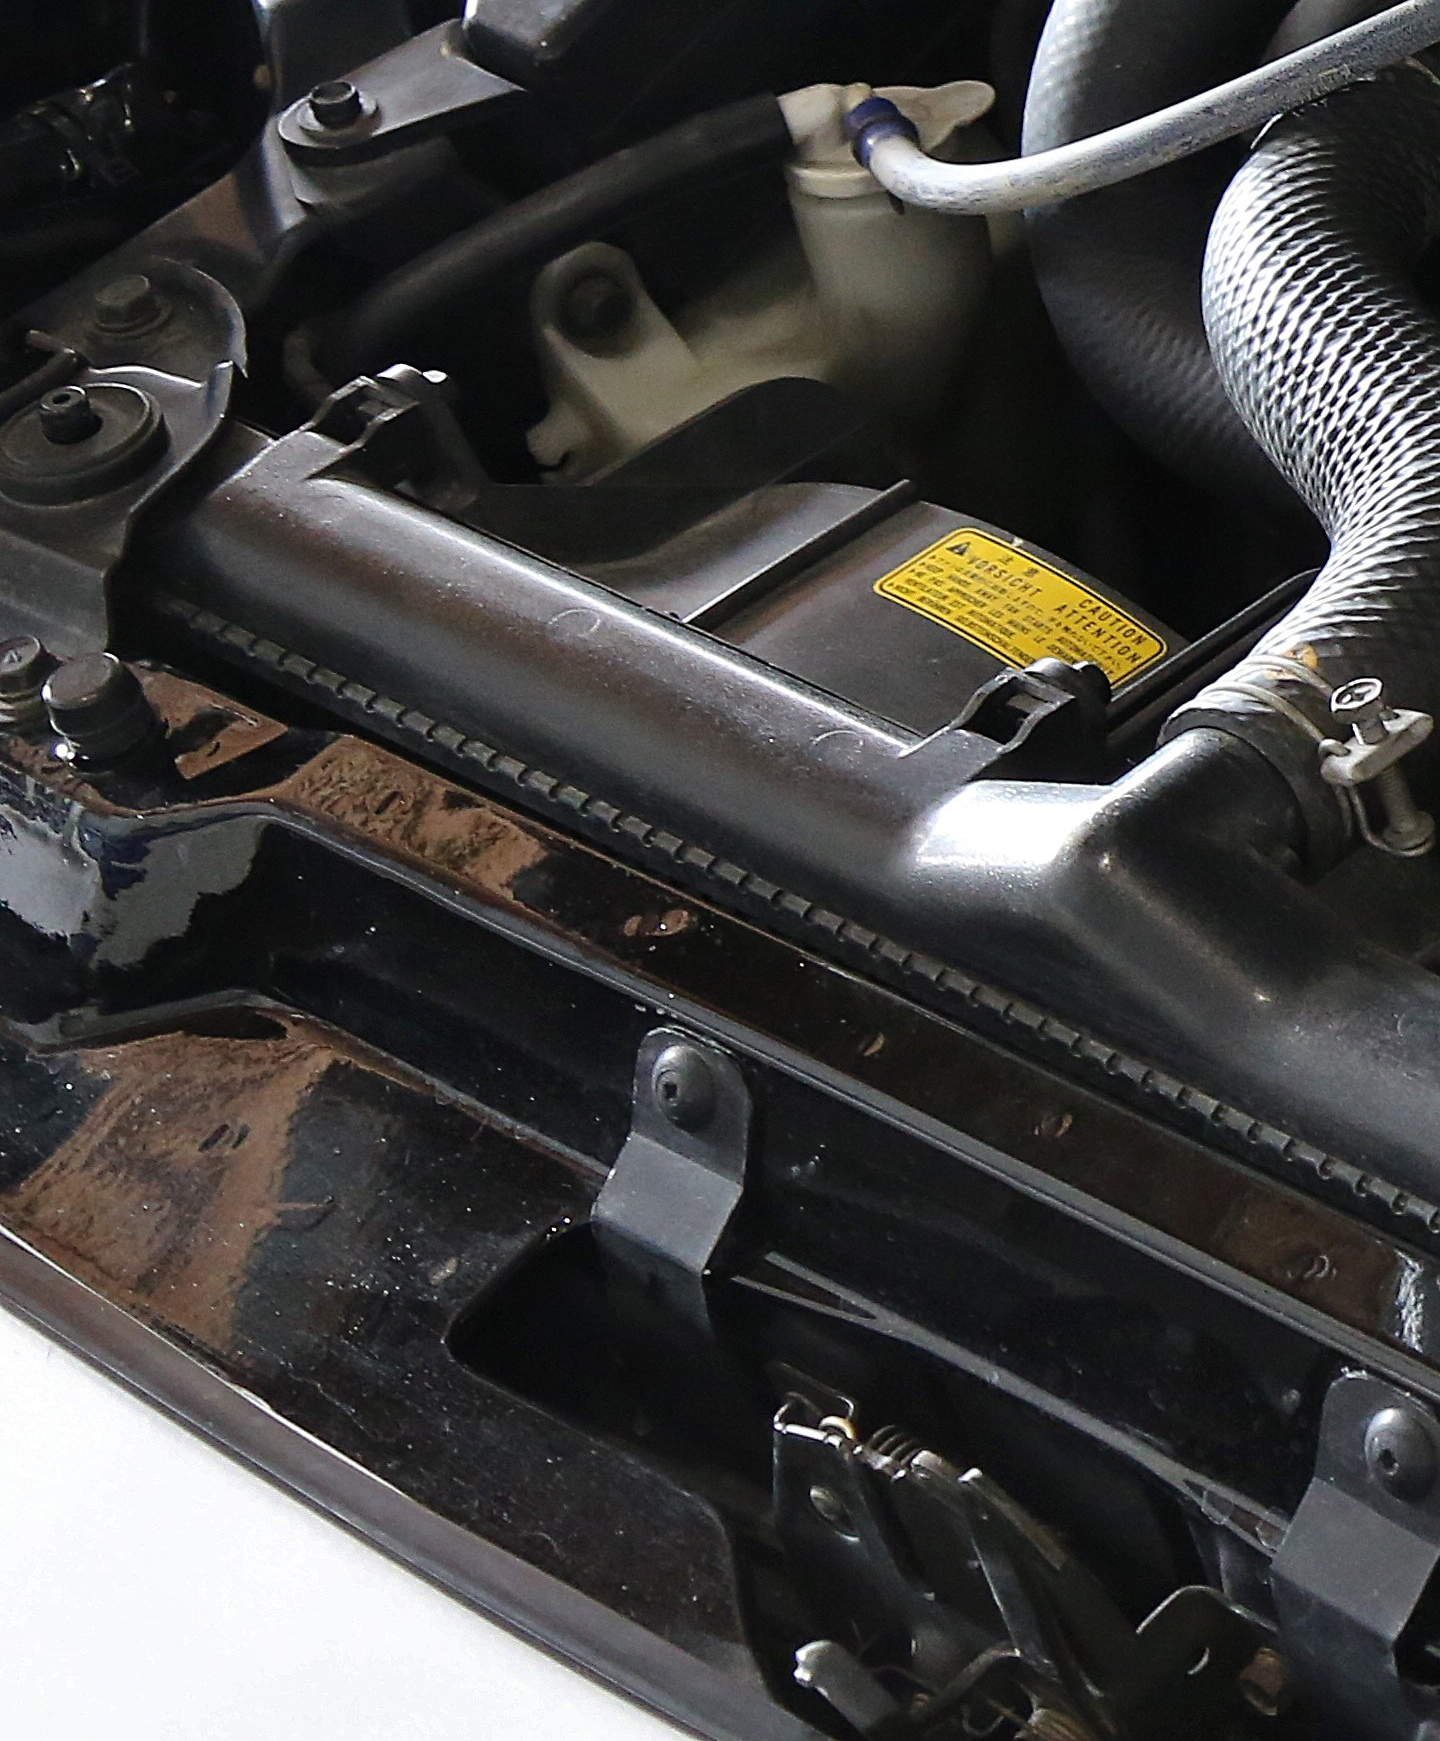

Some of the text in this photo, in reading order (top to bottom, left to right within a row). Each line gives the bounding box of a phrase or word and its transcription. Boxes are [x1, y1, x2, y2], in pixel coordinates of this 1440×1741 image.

[967, 553, 1043, 598] VORSICHT
[1055, 604, 1142, 664] ATTENTION
[1079, 599, 1148, 645] CAUTION
